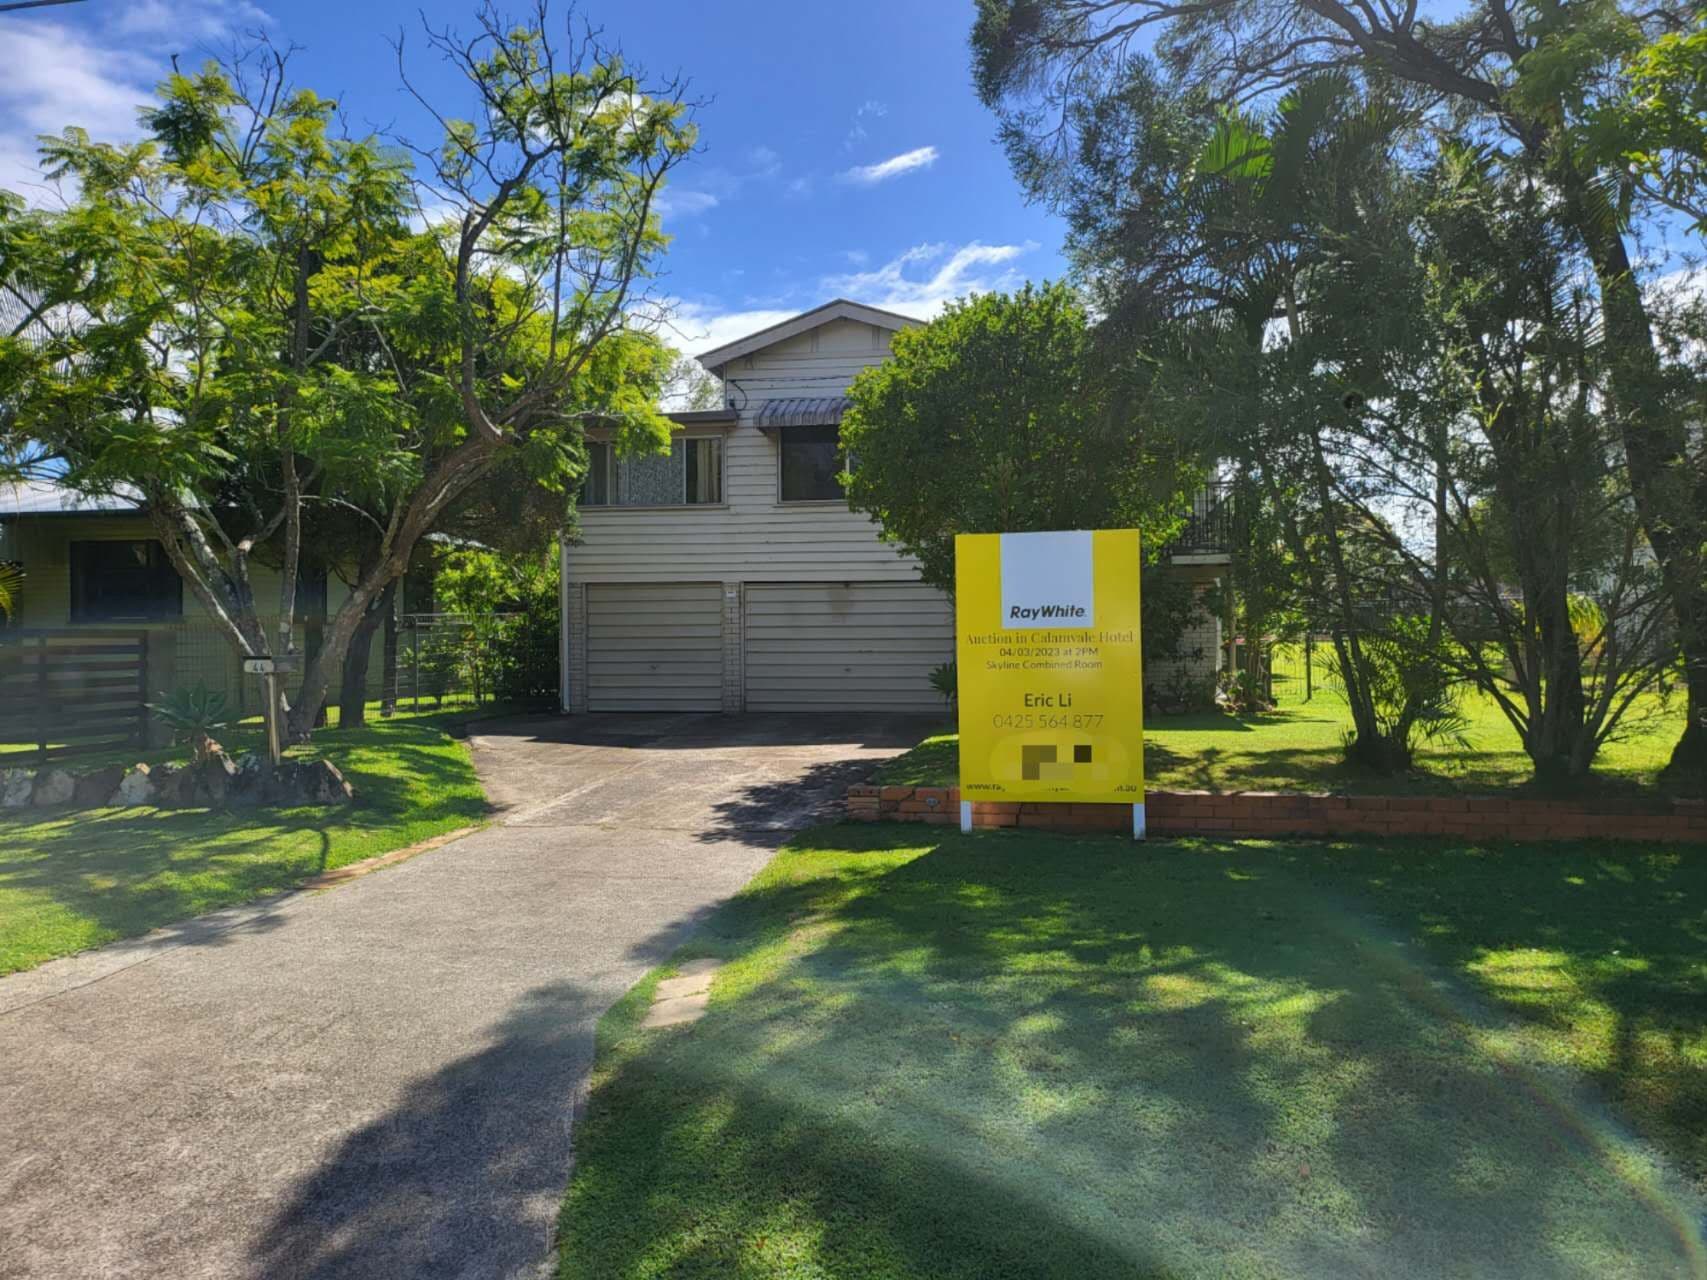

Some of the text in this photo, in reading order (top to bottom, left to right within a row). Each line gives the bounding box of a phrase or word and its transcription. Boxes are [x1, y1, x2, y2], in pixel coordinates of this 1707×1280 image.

[967, 631, 1133, 645] Auction in Calamvale Hotel
[999, 647, 1098, 657] 04/03/2023 at 2PM
[986, 659, 1103, 671] Skyline Combined Room
[1024, 693, 1072, 708] Eric Li
[992, 714, 1104, 729] 0425 564 877
